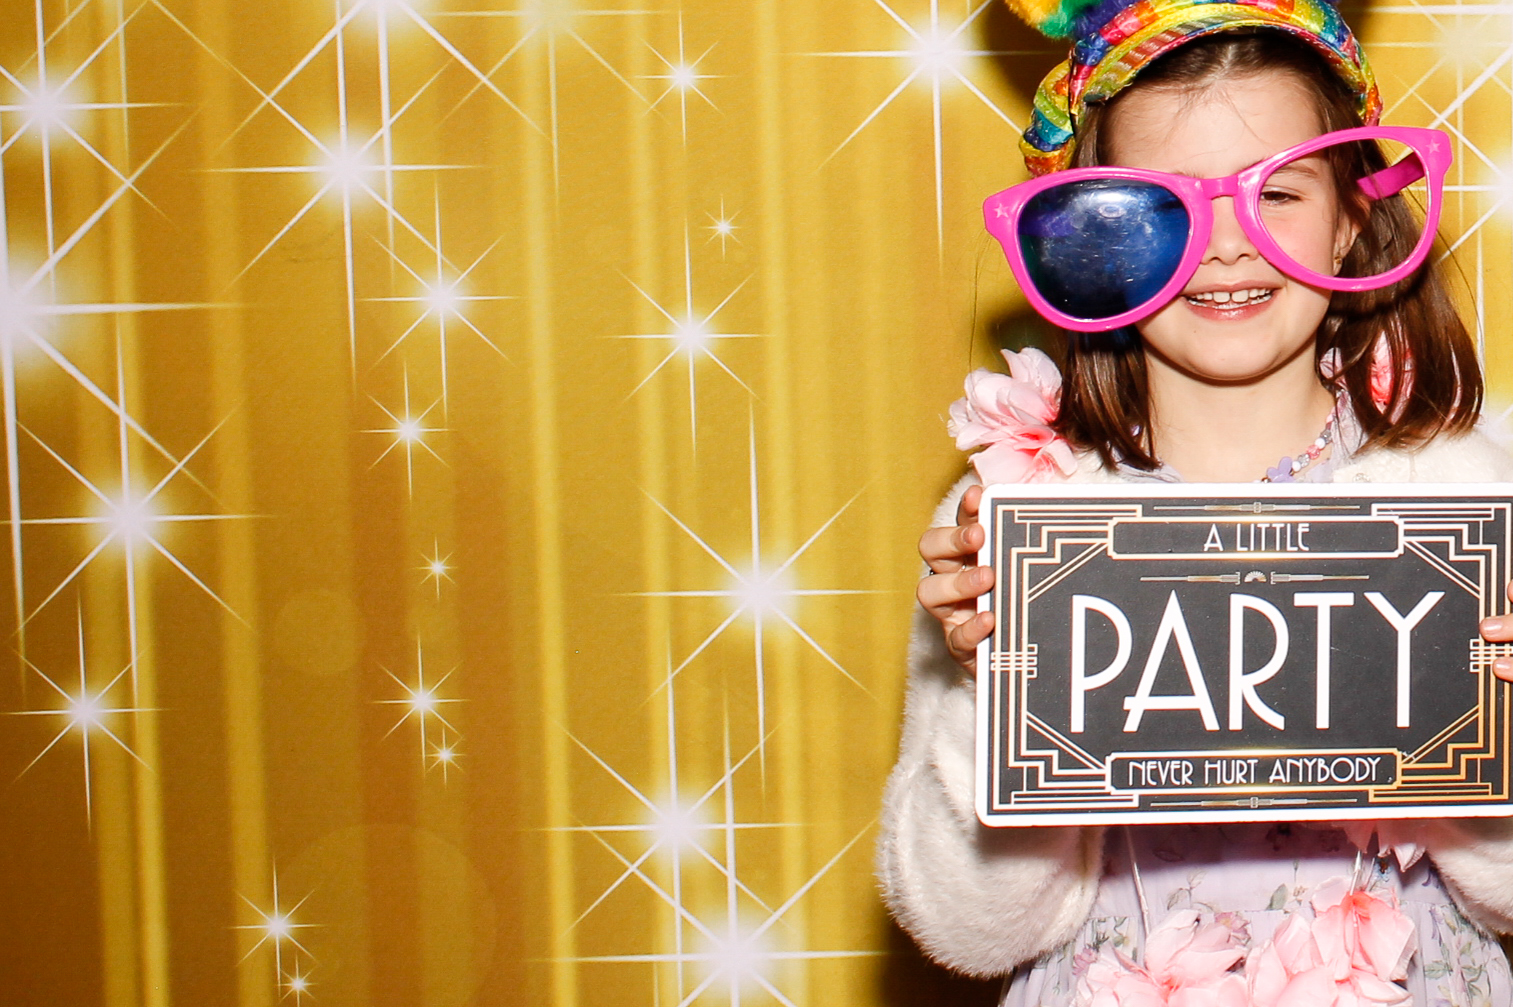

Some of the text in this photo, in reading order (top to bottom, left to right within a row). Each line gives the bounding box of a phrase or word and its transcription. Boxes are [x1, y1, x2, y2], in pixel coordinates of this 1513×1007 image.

[1204, 522, 1310, 552] A LITTLE
[1070, 589, 1445, 733] PARTY
[1128, 757, 1382, 786] NEVER HURT ANYBODY
